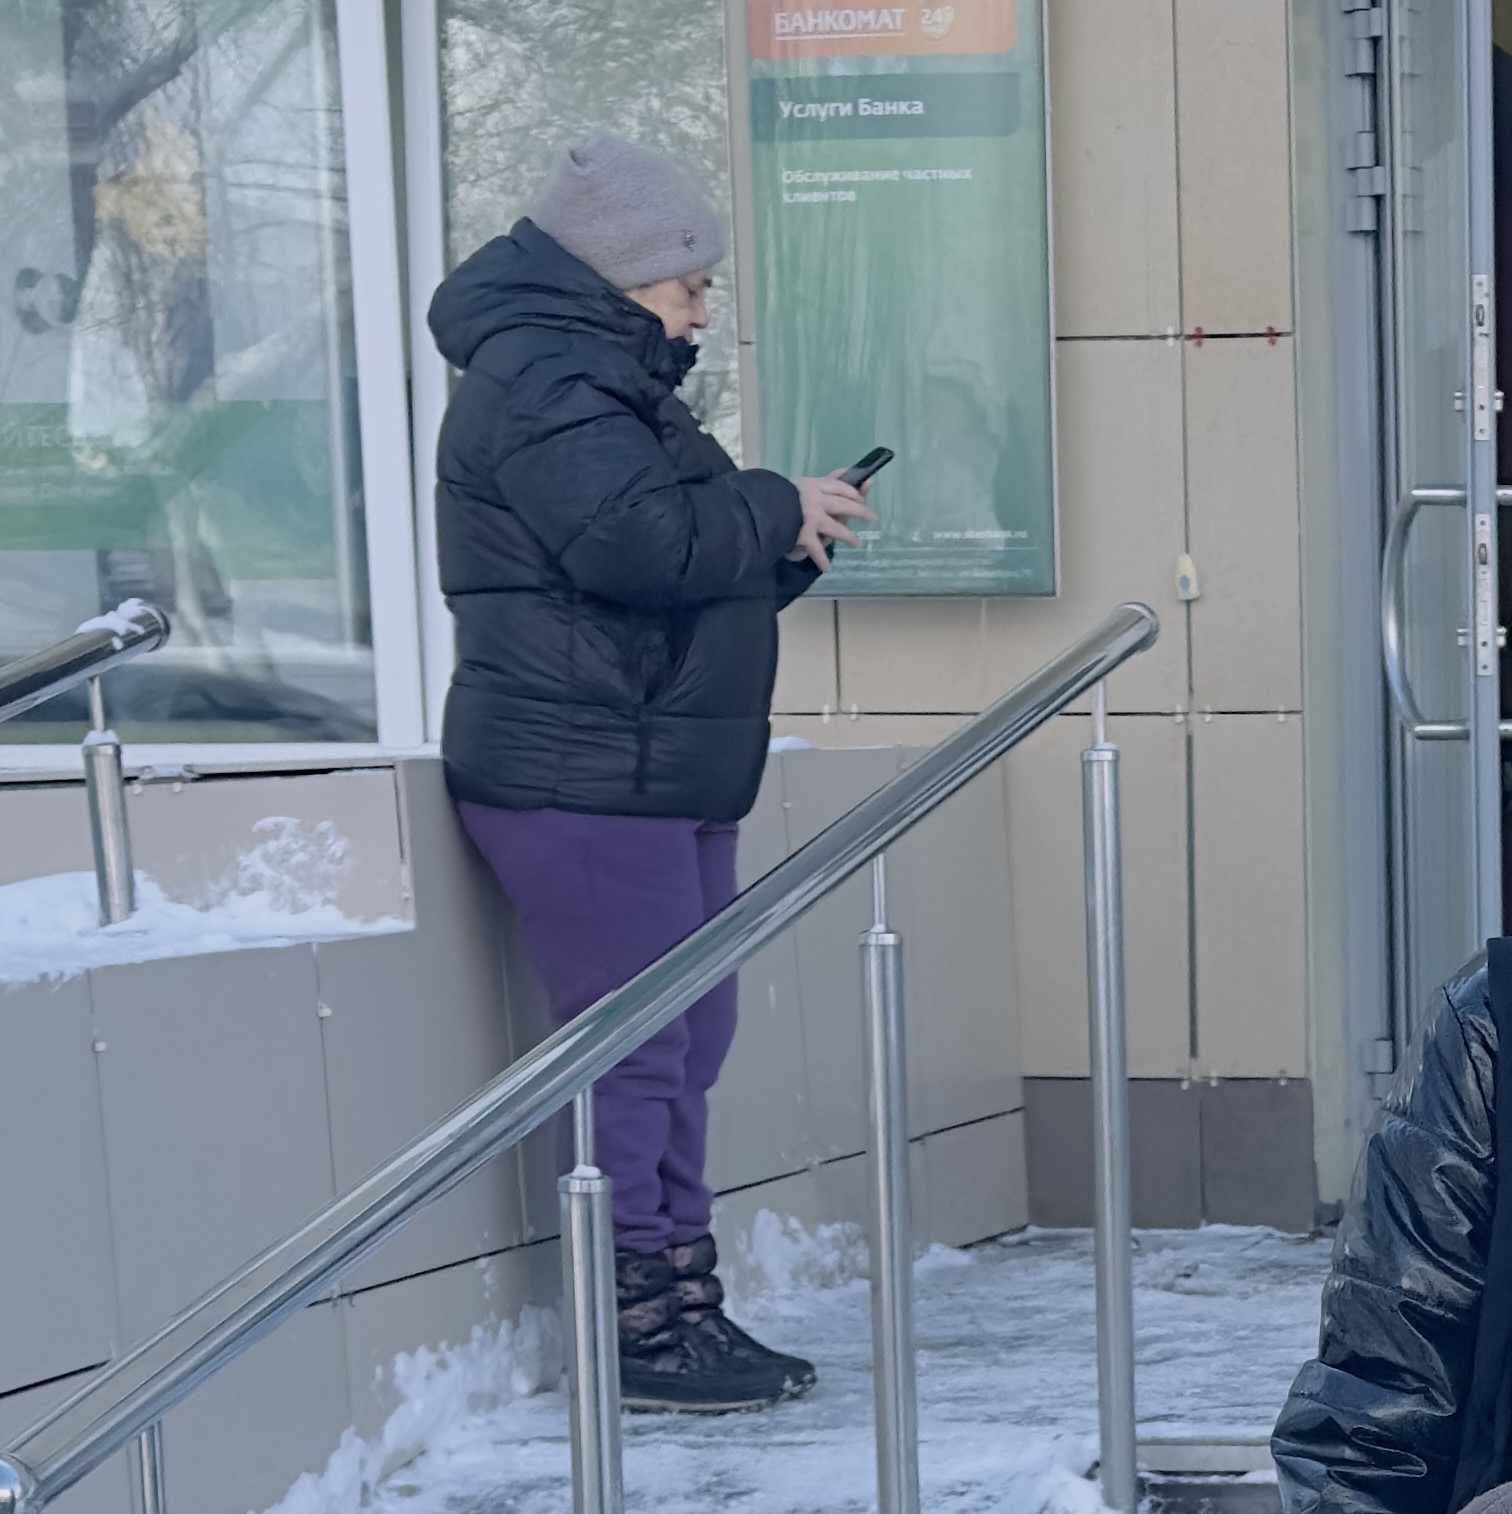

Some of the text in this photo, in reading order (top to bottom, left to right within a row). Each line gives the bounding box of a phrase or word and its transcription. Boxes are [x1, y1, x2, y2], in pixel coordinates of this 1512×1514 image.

[774, 8, 905, 34] БАНКОМАТ
[779, 98, 924, 121] Услуги Банка
